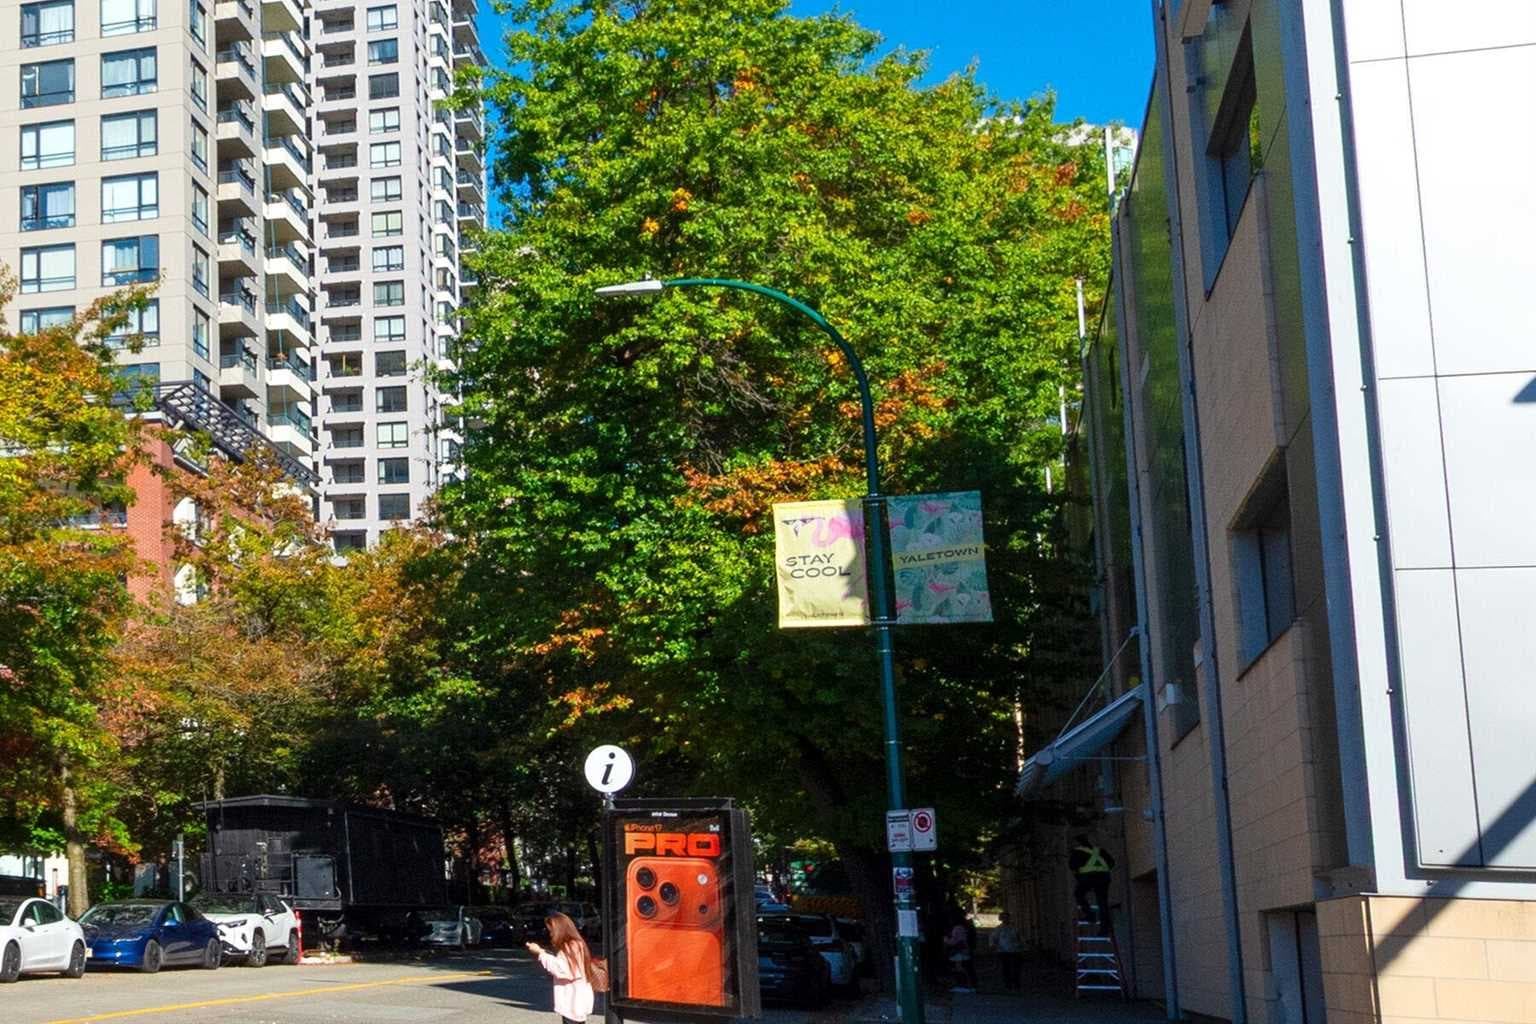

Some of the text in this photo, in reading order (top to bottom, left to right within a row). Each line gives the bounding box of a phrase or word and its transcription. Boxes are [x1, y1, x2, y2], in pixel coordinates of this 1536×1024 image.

[785, 553, 834, 567] STAY
[899, 547, 979, 564] YALETOWN
[791, 566, 851, 579] COOL
[624, 832, 720, 856] PRO
